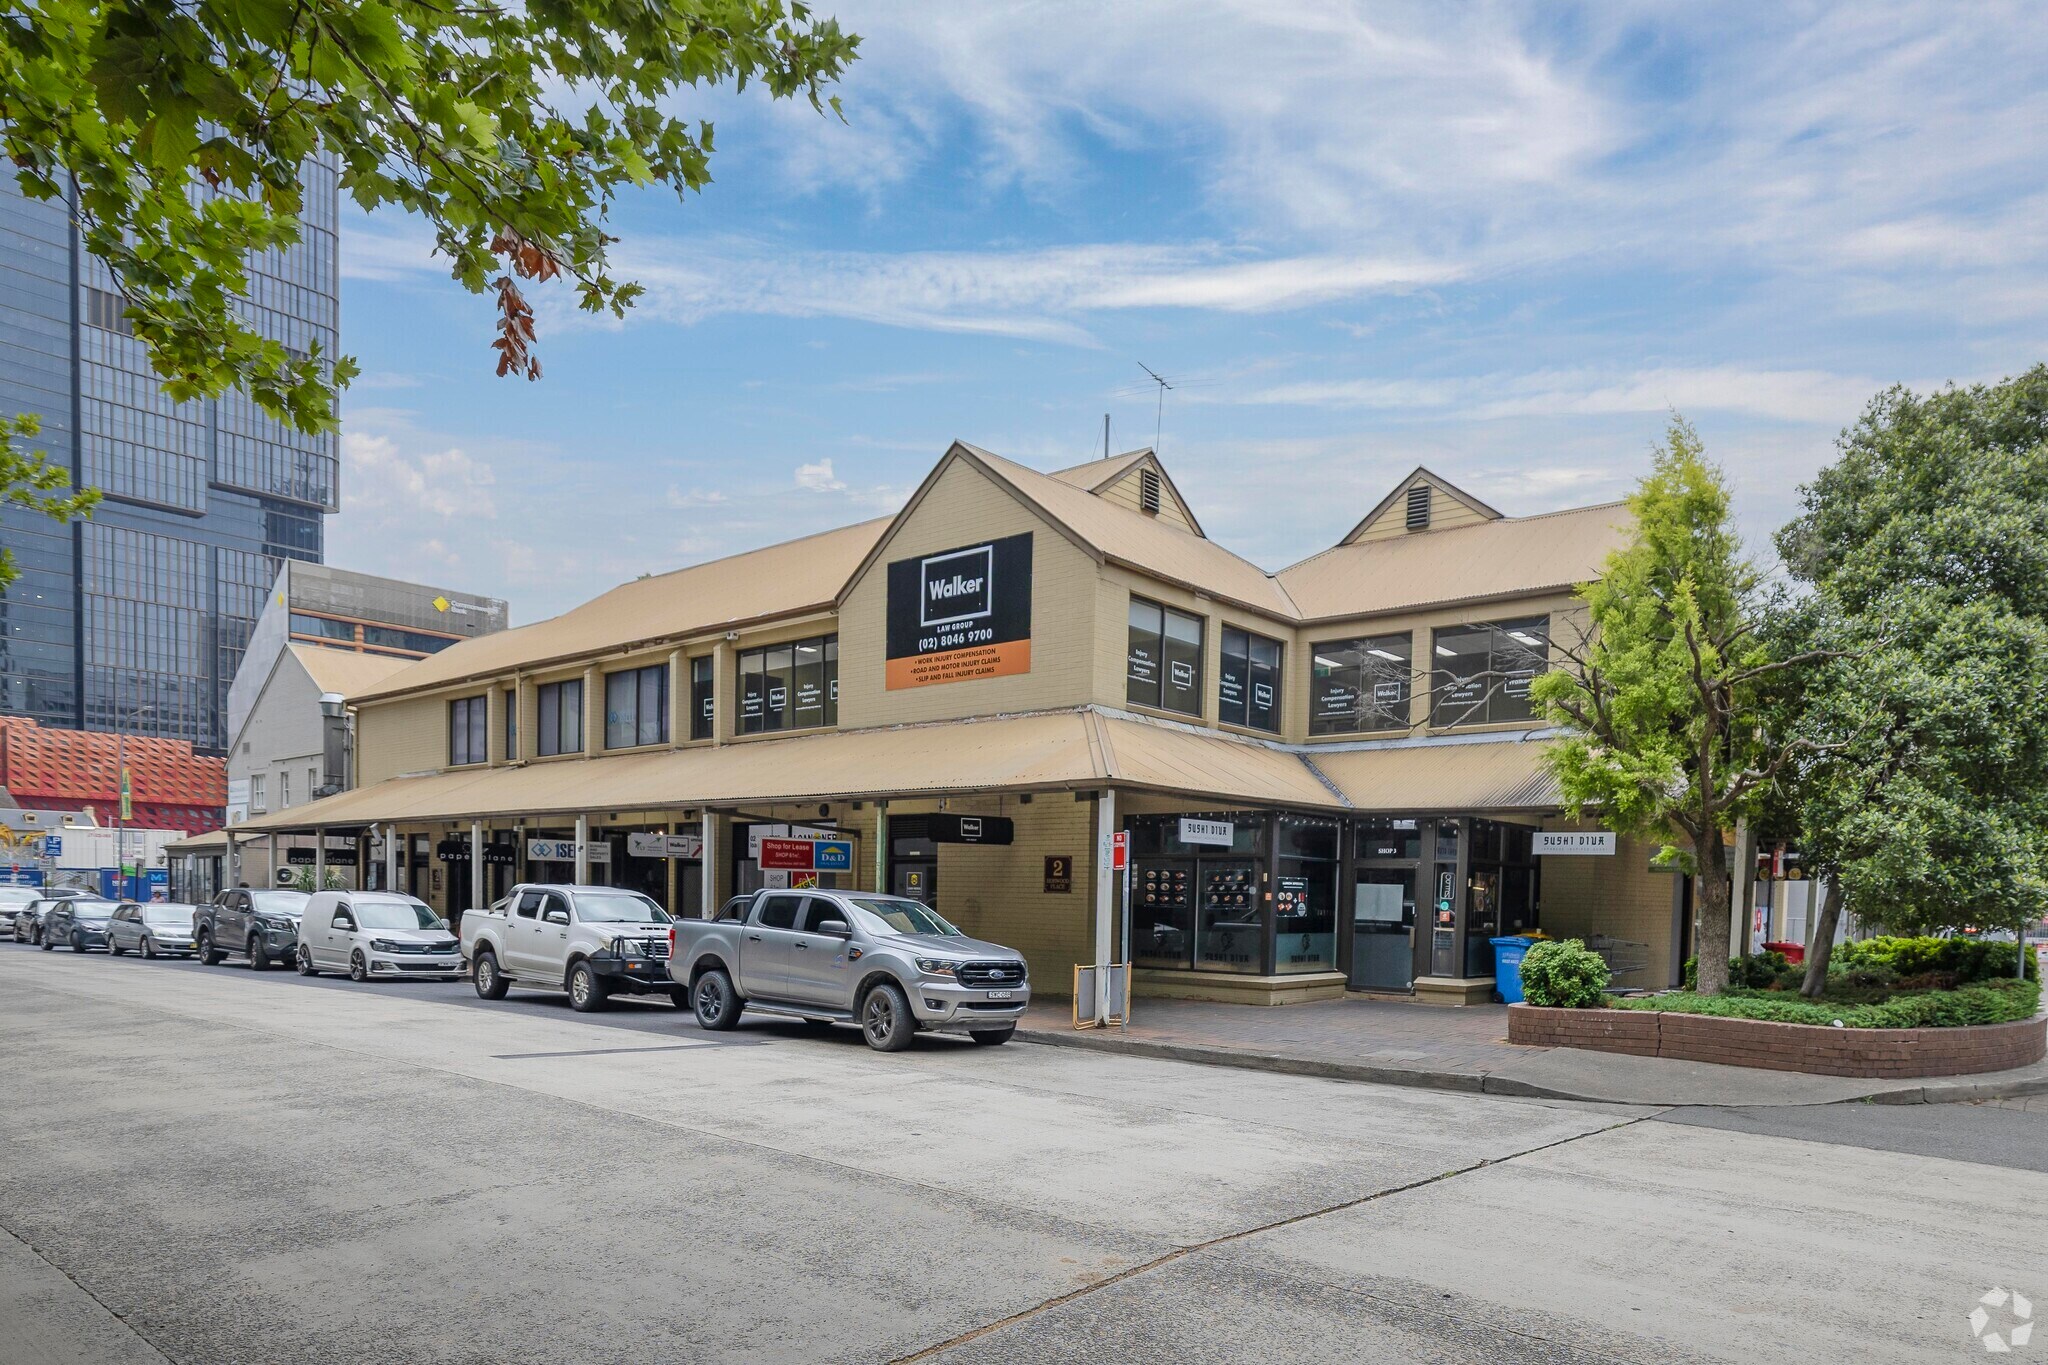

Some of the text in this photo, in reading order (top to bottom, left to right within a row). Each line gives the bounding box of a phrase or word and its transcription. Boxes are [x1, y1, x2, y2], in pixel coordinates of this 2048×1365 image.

[929, 575, 983, 600] Walker
[937, 621, 973, 633] LAW GROUP
[918, 628, 992, 652] (02) 8046 9700
[954, 648, 996, 660] COMPENSATION
[975, 666, 994, 674] CLAIMS
[1544, 837, 1573, 845] SUSHI
[1053, 860, 1063, 876] 2
